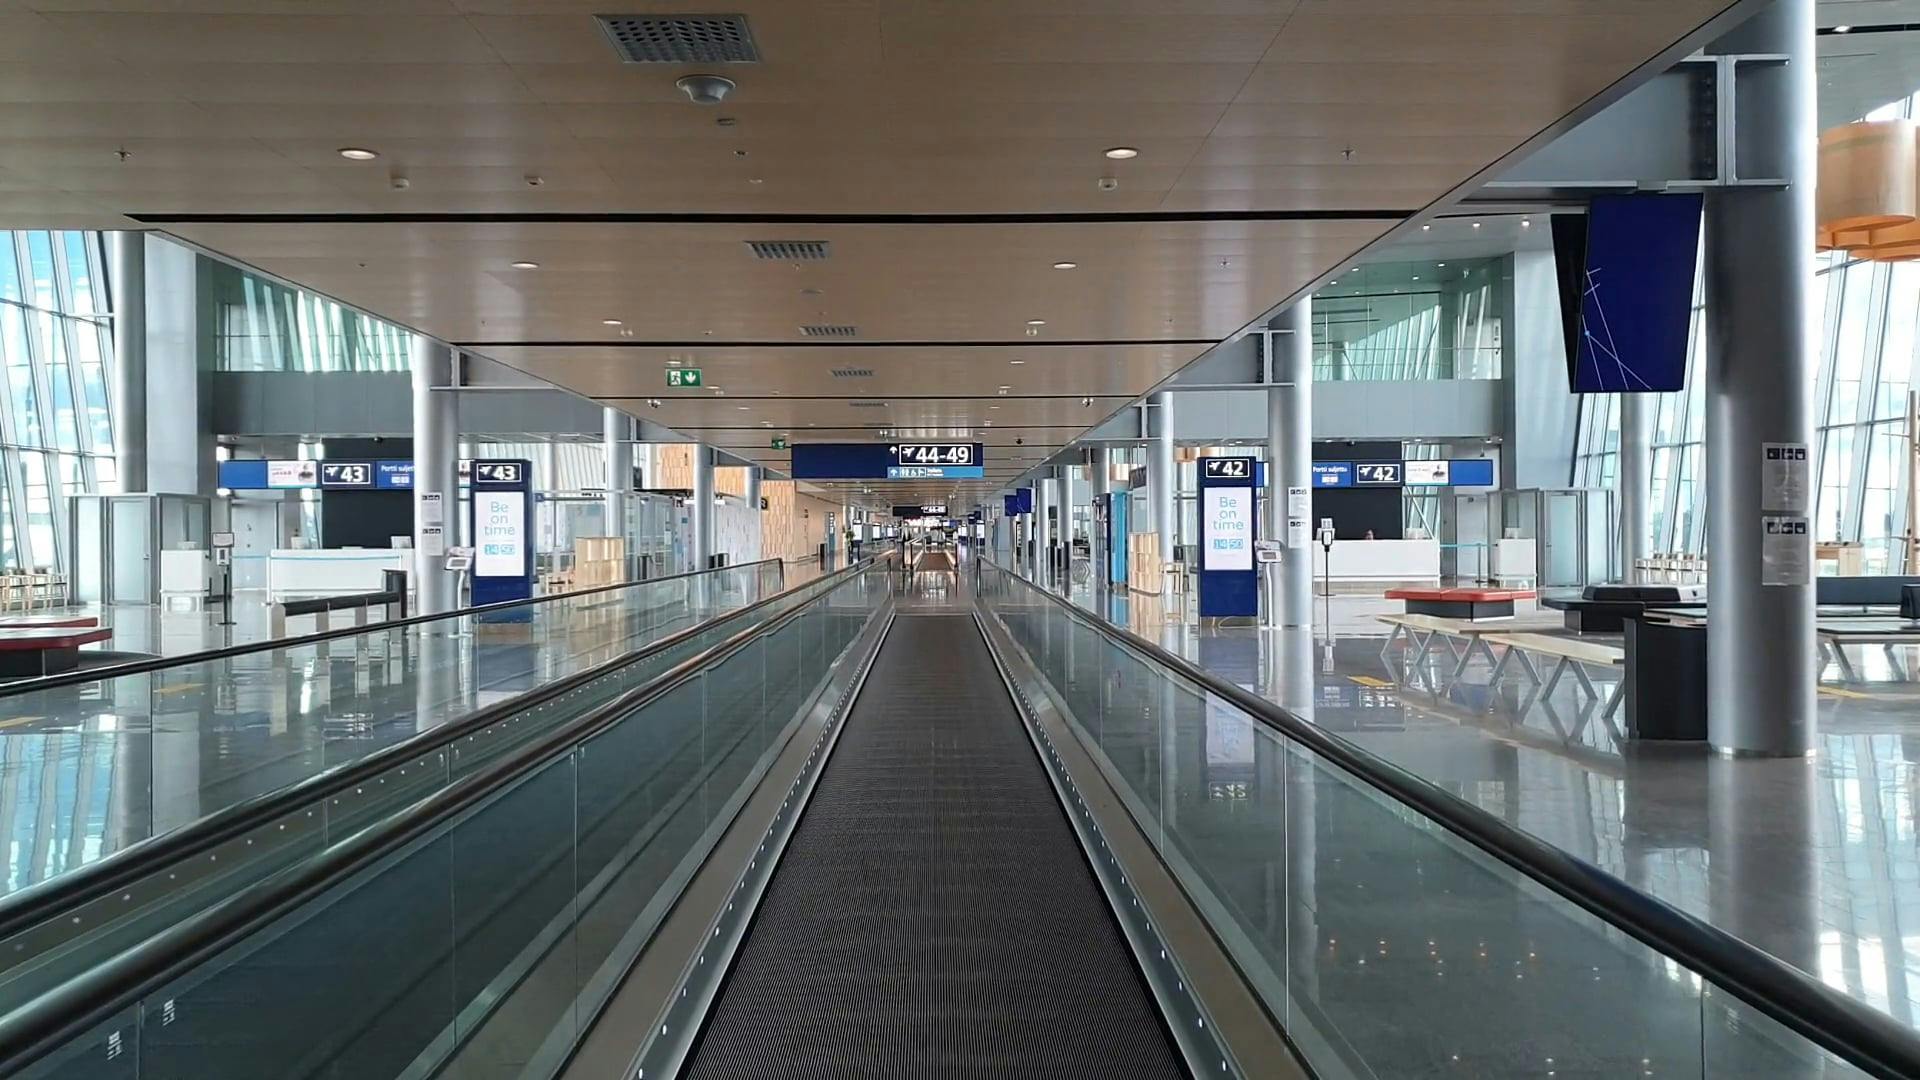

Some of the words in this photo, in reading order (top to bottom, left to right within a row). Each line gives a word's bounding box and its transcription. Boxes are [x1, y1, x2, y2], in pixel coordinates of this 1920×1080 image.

[915, 446, 969, 463] 44-49
[340, 466, 363, 482] 43
[493, 465, 515, 480] 43
[1222, 461, 1243, 475] 42
[1373, 466, 1394, 480] 42
[491, 501, 509, 513] Be
[1219, 496, 1237, 508] Be
[490, 515, 508, 524] on
[1219, 510, 1237, 519] on
[484, 525, 515, 536] time
[1213, 519, 1244, 530] time
